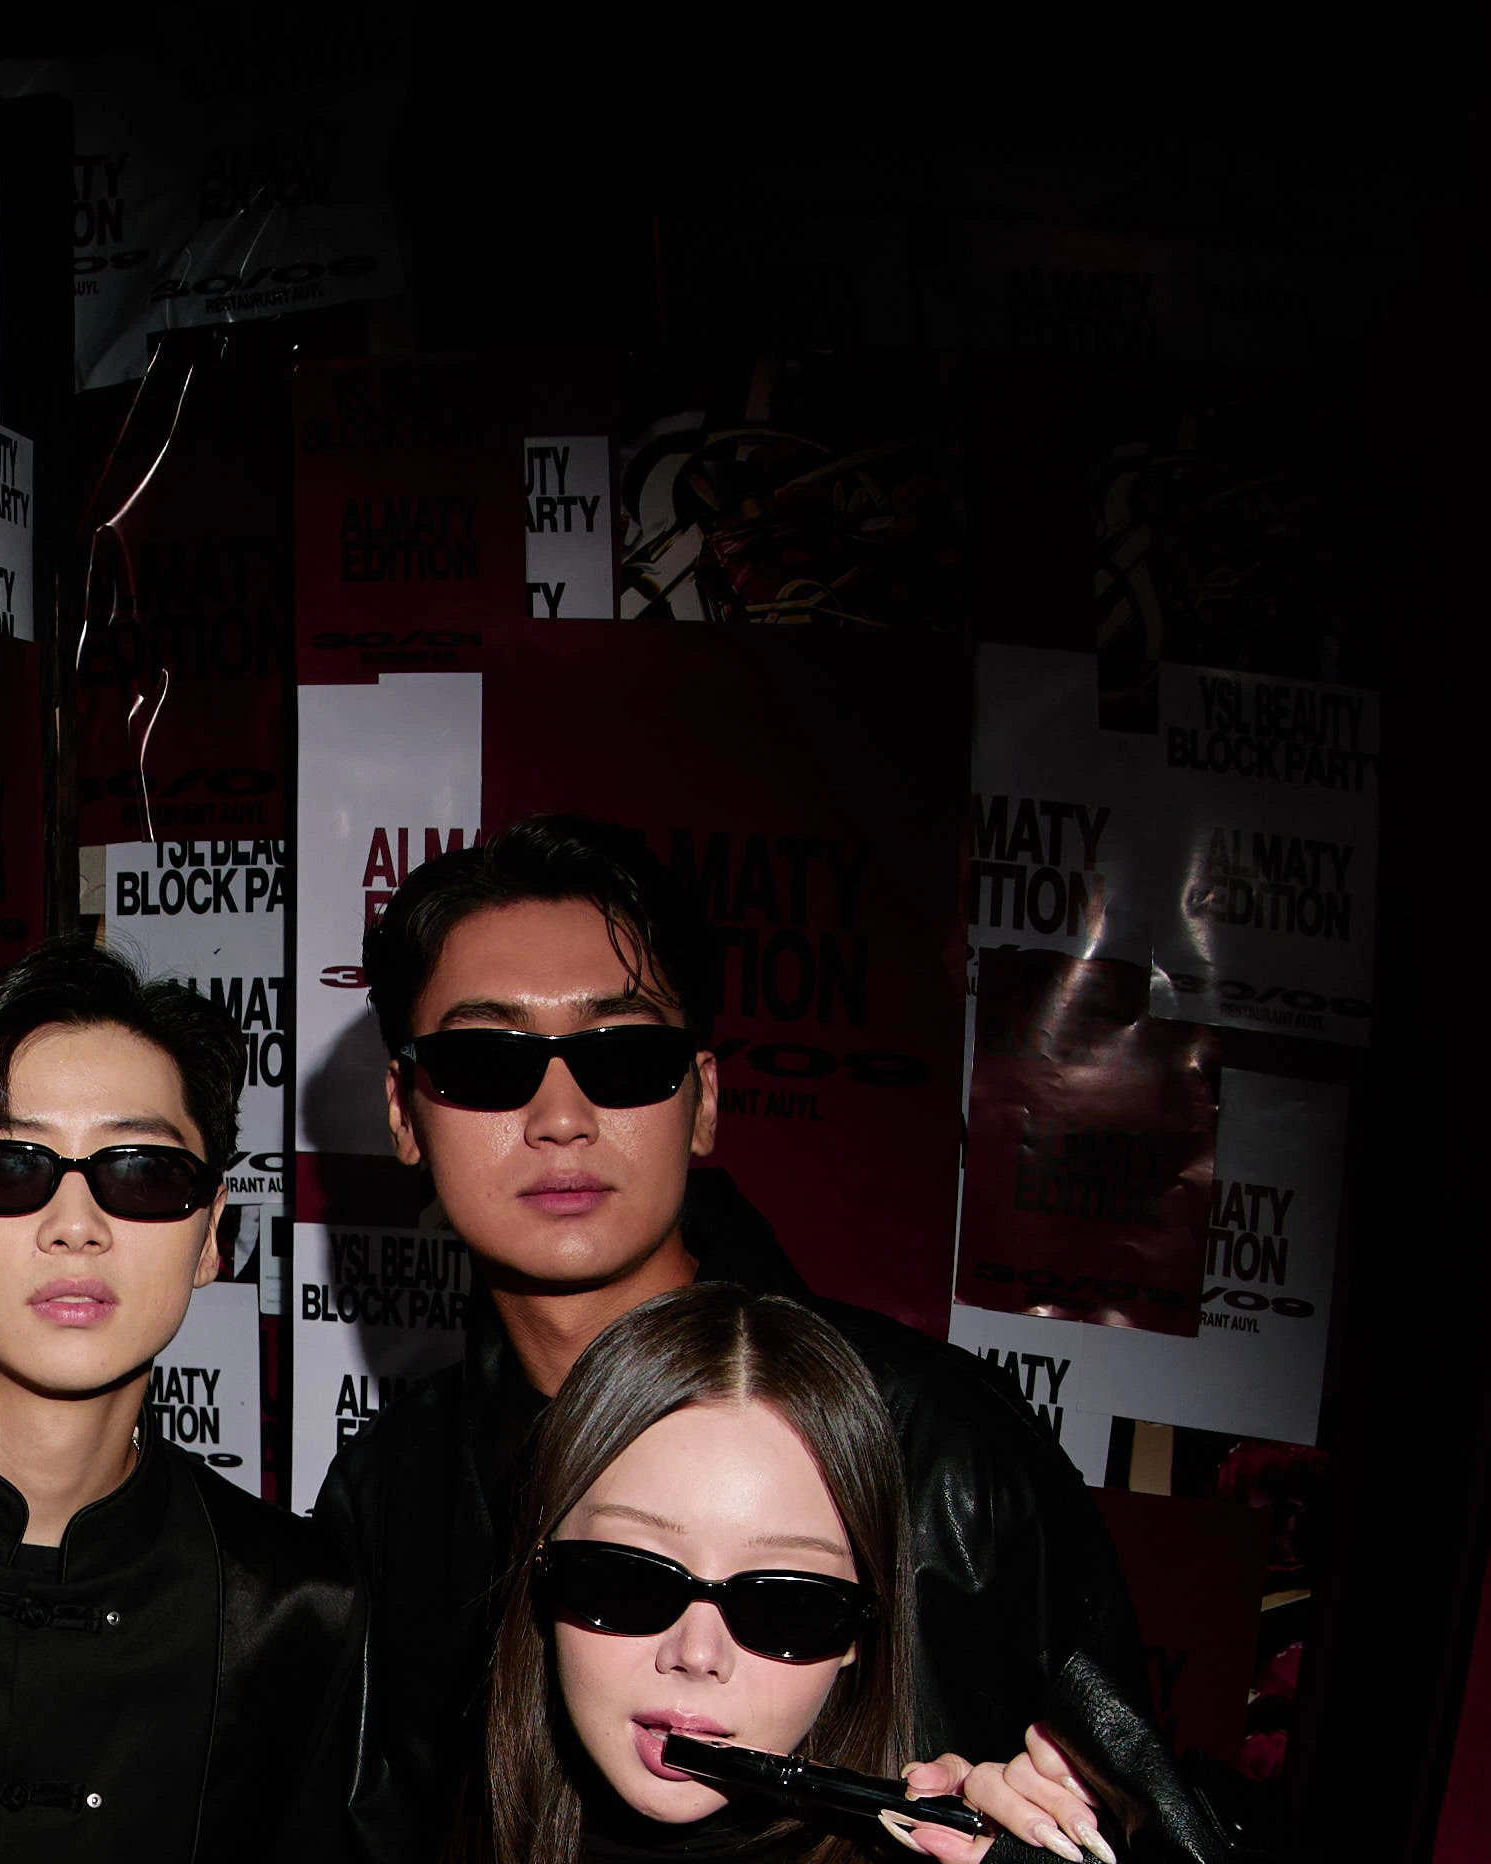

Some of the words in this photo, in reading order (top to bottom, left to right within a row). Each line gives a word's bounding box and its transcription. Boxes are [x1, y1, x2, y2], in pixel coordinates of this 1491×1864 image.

[1200, 674, 1250, 734] YSL
[1254, 682, 1364, 749] BEAUTY
[1167, 727, 1279, 779] BLOCK
[971, 793, 1111, 870] MATY
[1208, 826, 1355, 891] ALMATY
[117, 868, 239, 915] BLOCK
[671, 830, 872, 929] MATY
[970, 857, 1106, 937] ITION
[1206, 877, 1350, 942] EDITION
[1208, 1179, 1294, 1236] MATY
[331, 1233, 377, 1285] YSL
[381, 1236, 464, 1290] BEAUT
[1207, 1227, 1288, 1286] TION
[302, 1284, 405, 1327] BLOCK
[409, 1290, 467, 1330] PAR
[1201, 1286, 1315, 1318] /09
[1230, 1315, 1260, 1333] AUYL
[148, 1366, 220, 1405] MATY
